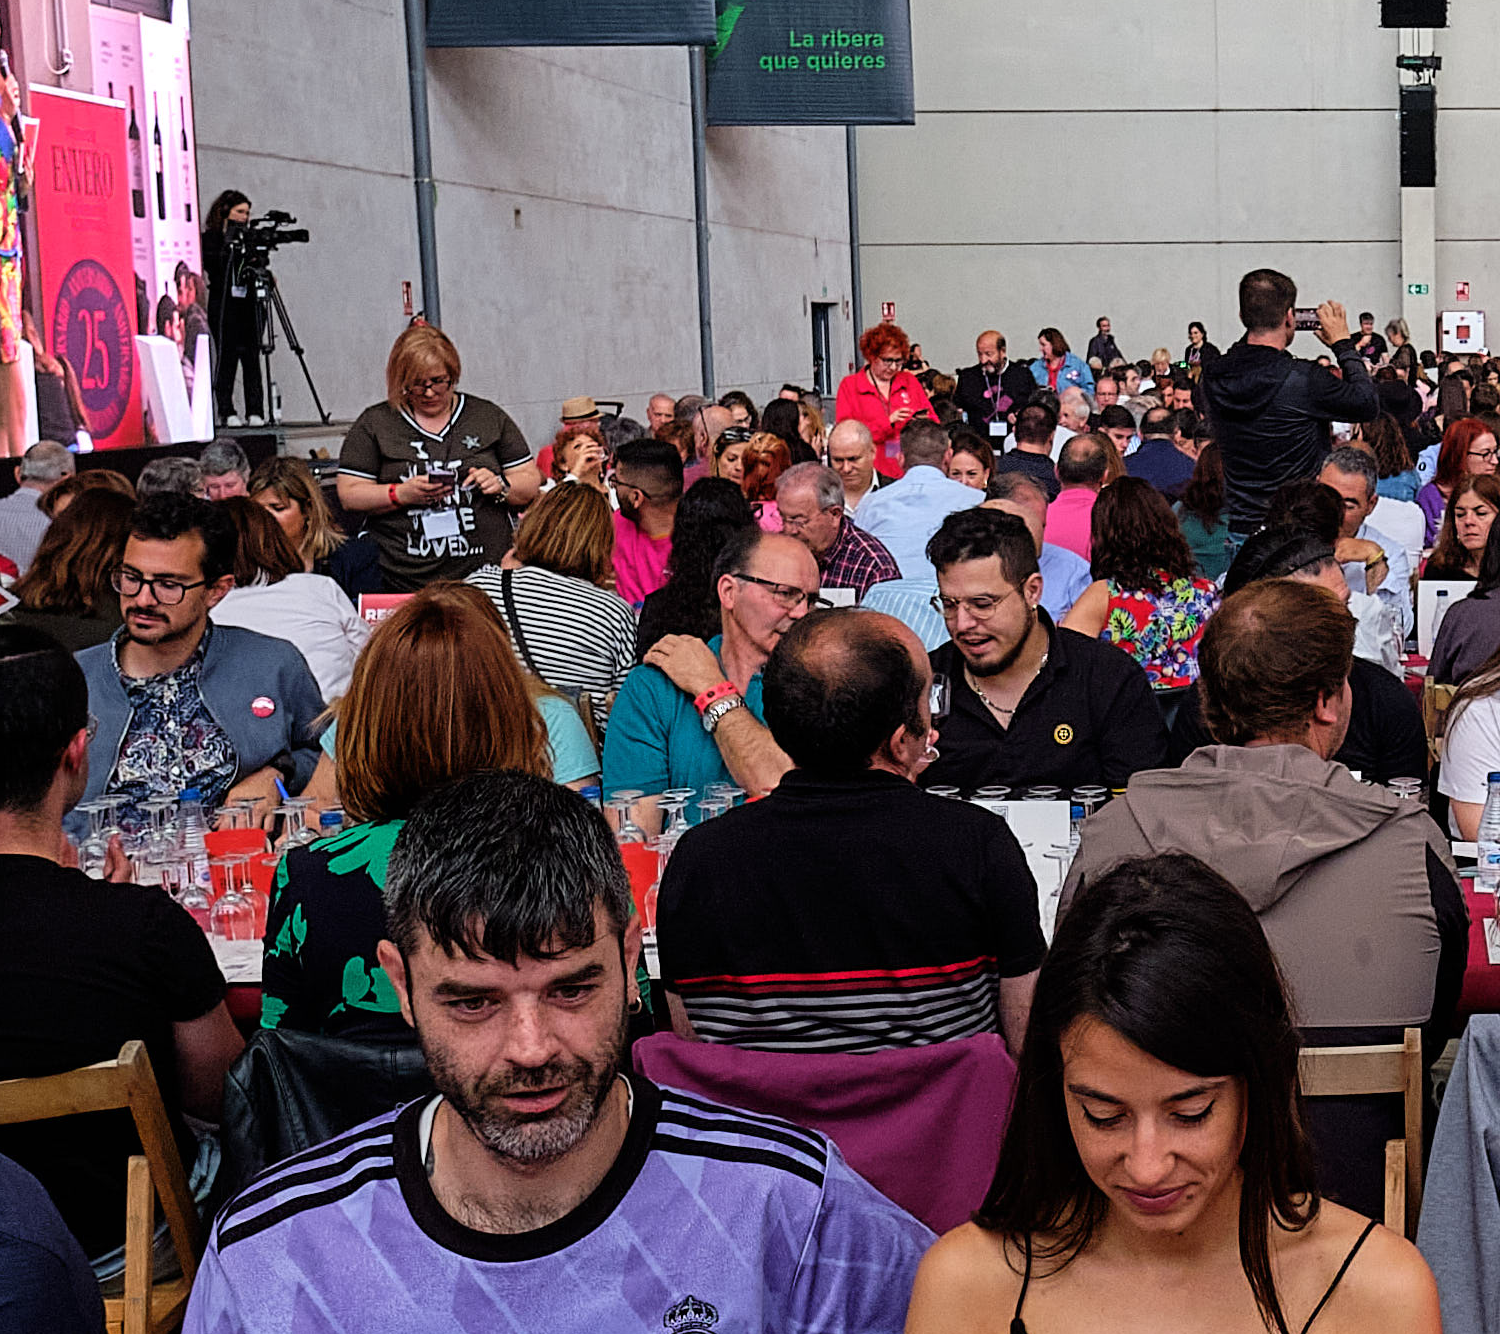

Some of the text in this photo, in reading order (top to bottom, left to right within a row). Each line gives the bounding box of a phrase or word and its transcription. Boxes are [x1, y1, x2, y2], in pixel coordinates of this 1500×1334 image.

[789, 29, 884, 49] La ribera
[758, 51, 886, 72] que quieres
[51, 146, 115, 198] ENVERO
[77, 308, 111, 390] 25
